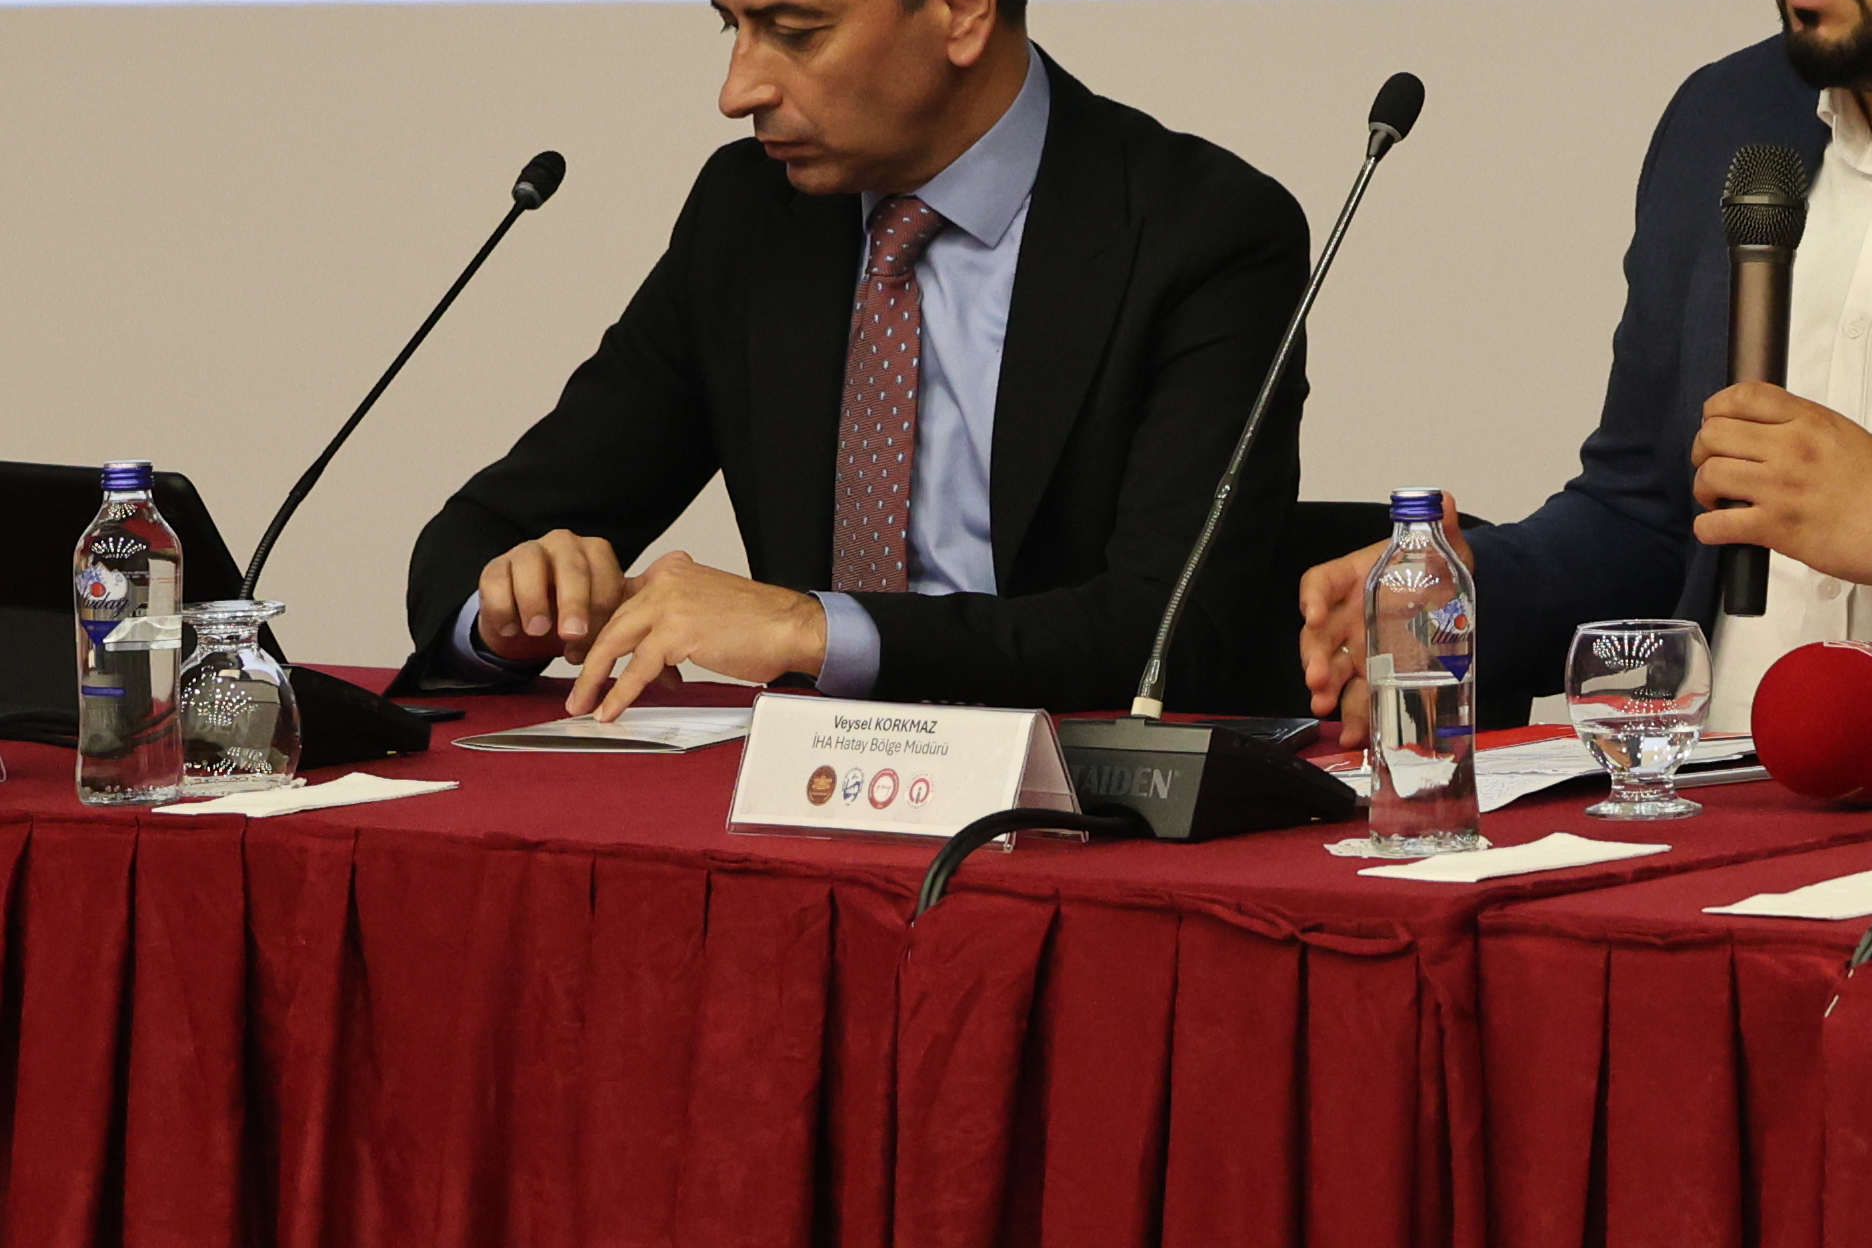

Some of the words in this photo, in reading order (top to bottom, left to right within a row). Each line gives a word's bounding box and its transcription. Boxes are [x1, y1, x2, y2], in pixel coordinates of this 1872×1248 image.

[834, 715, 873, 733] Veysel
[874, 717, 938, 734] KORKMAZ
[812, 732, 832, 749] İHA
[834, 736, 869, 754] Hatay
[870, 737, 902, 755] Bölge
[903, 739, 949, 756] Müdürü
